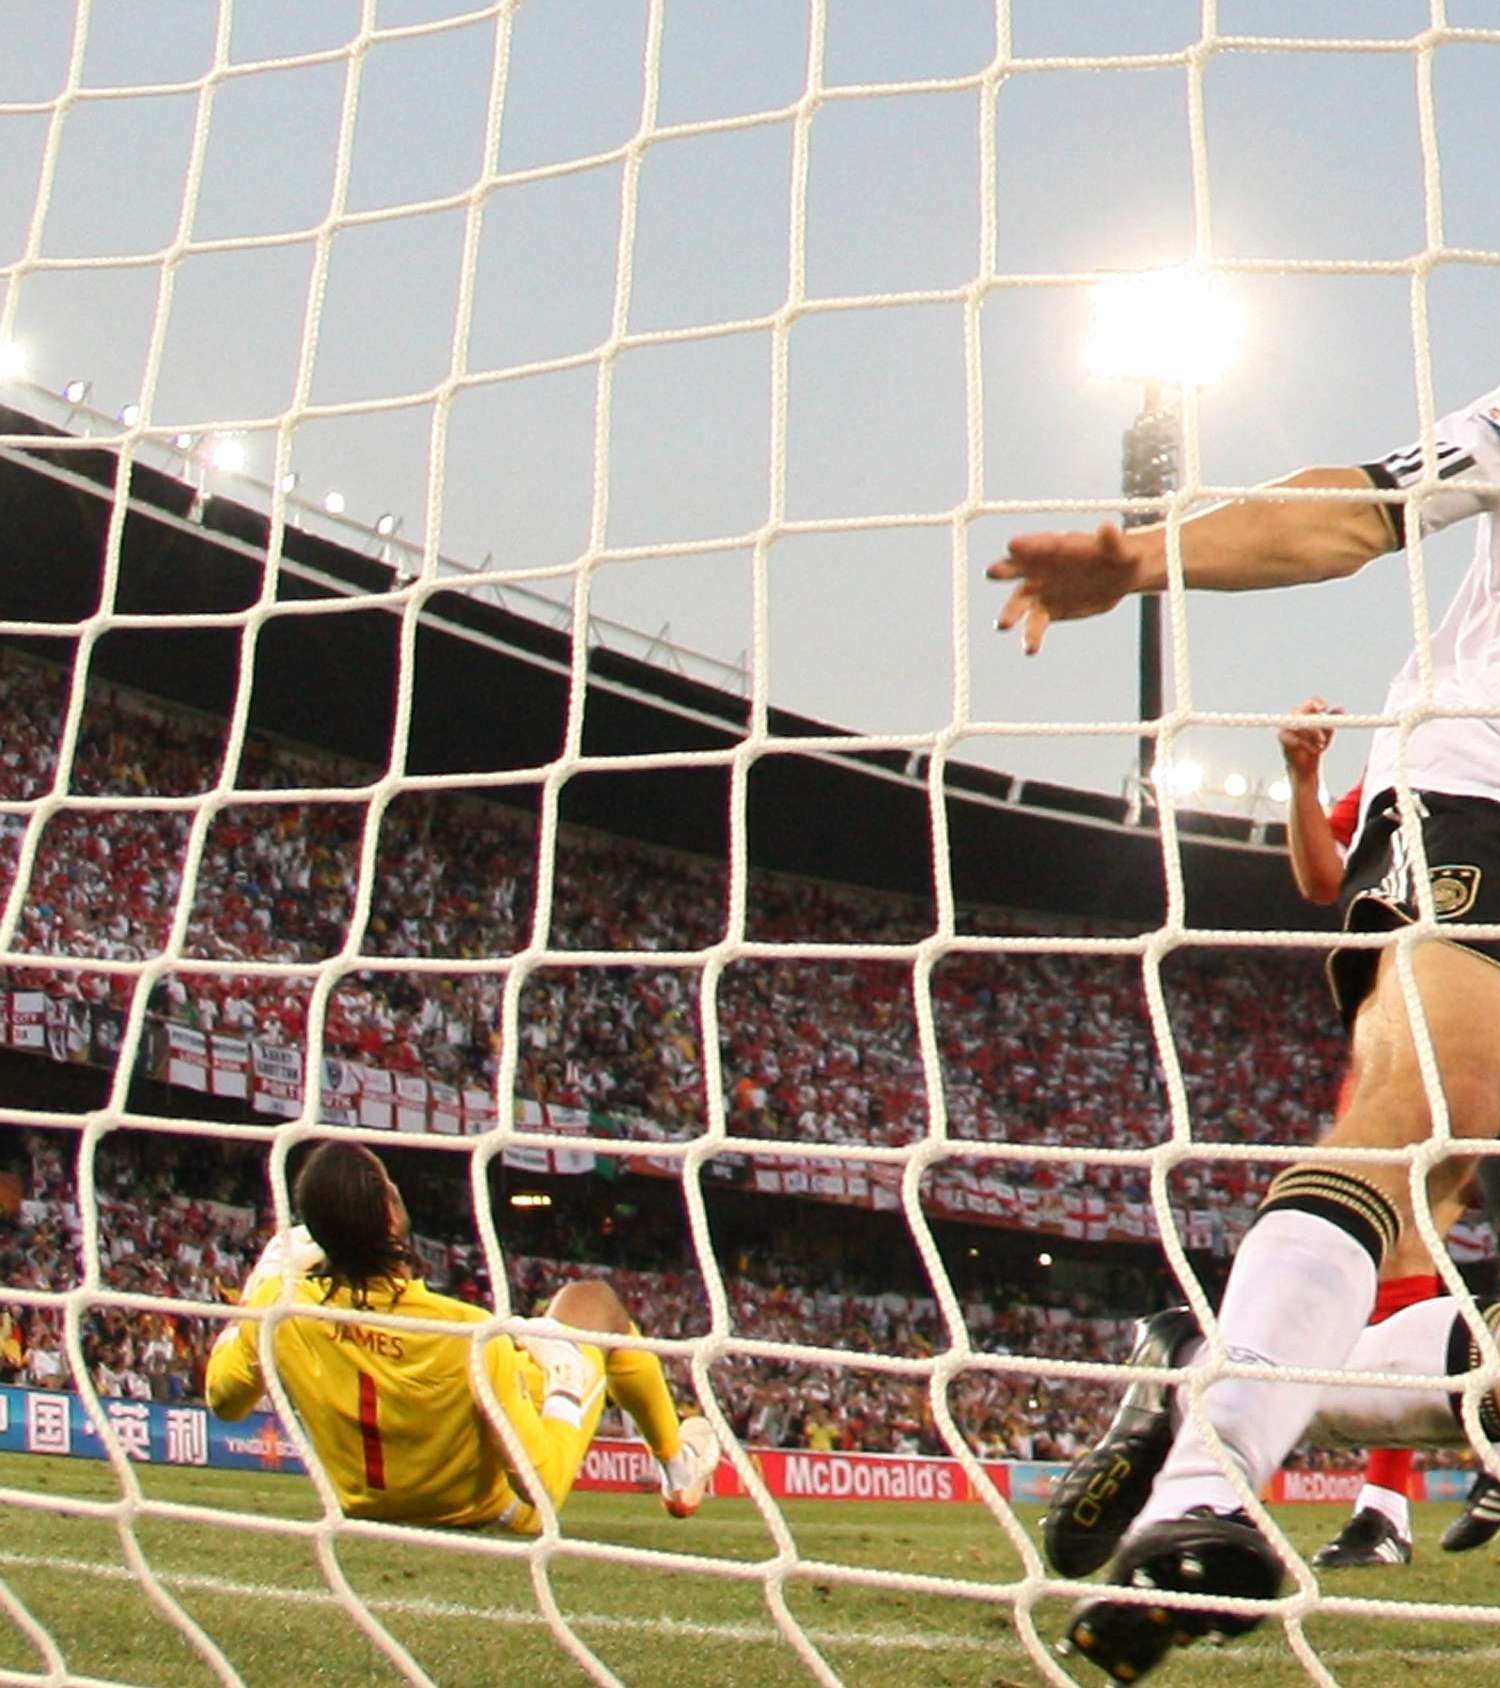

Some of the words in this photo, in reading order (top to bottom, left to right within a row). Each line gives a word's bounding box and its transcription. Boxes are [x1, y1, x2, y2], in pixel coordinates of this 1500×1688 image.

[329, 1322, 404, 1360] JAMES
[358, 1370, 387, 1490] 1
[785, 1455, 952, 1499] McDonald's
